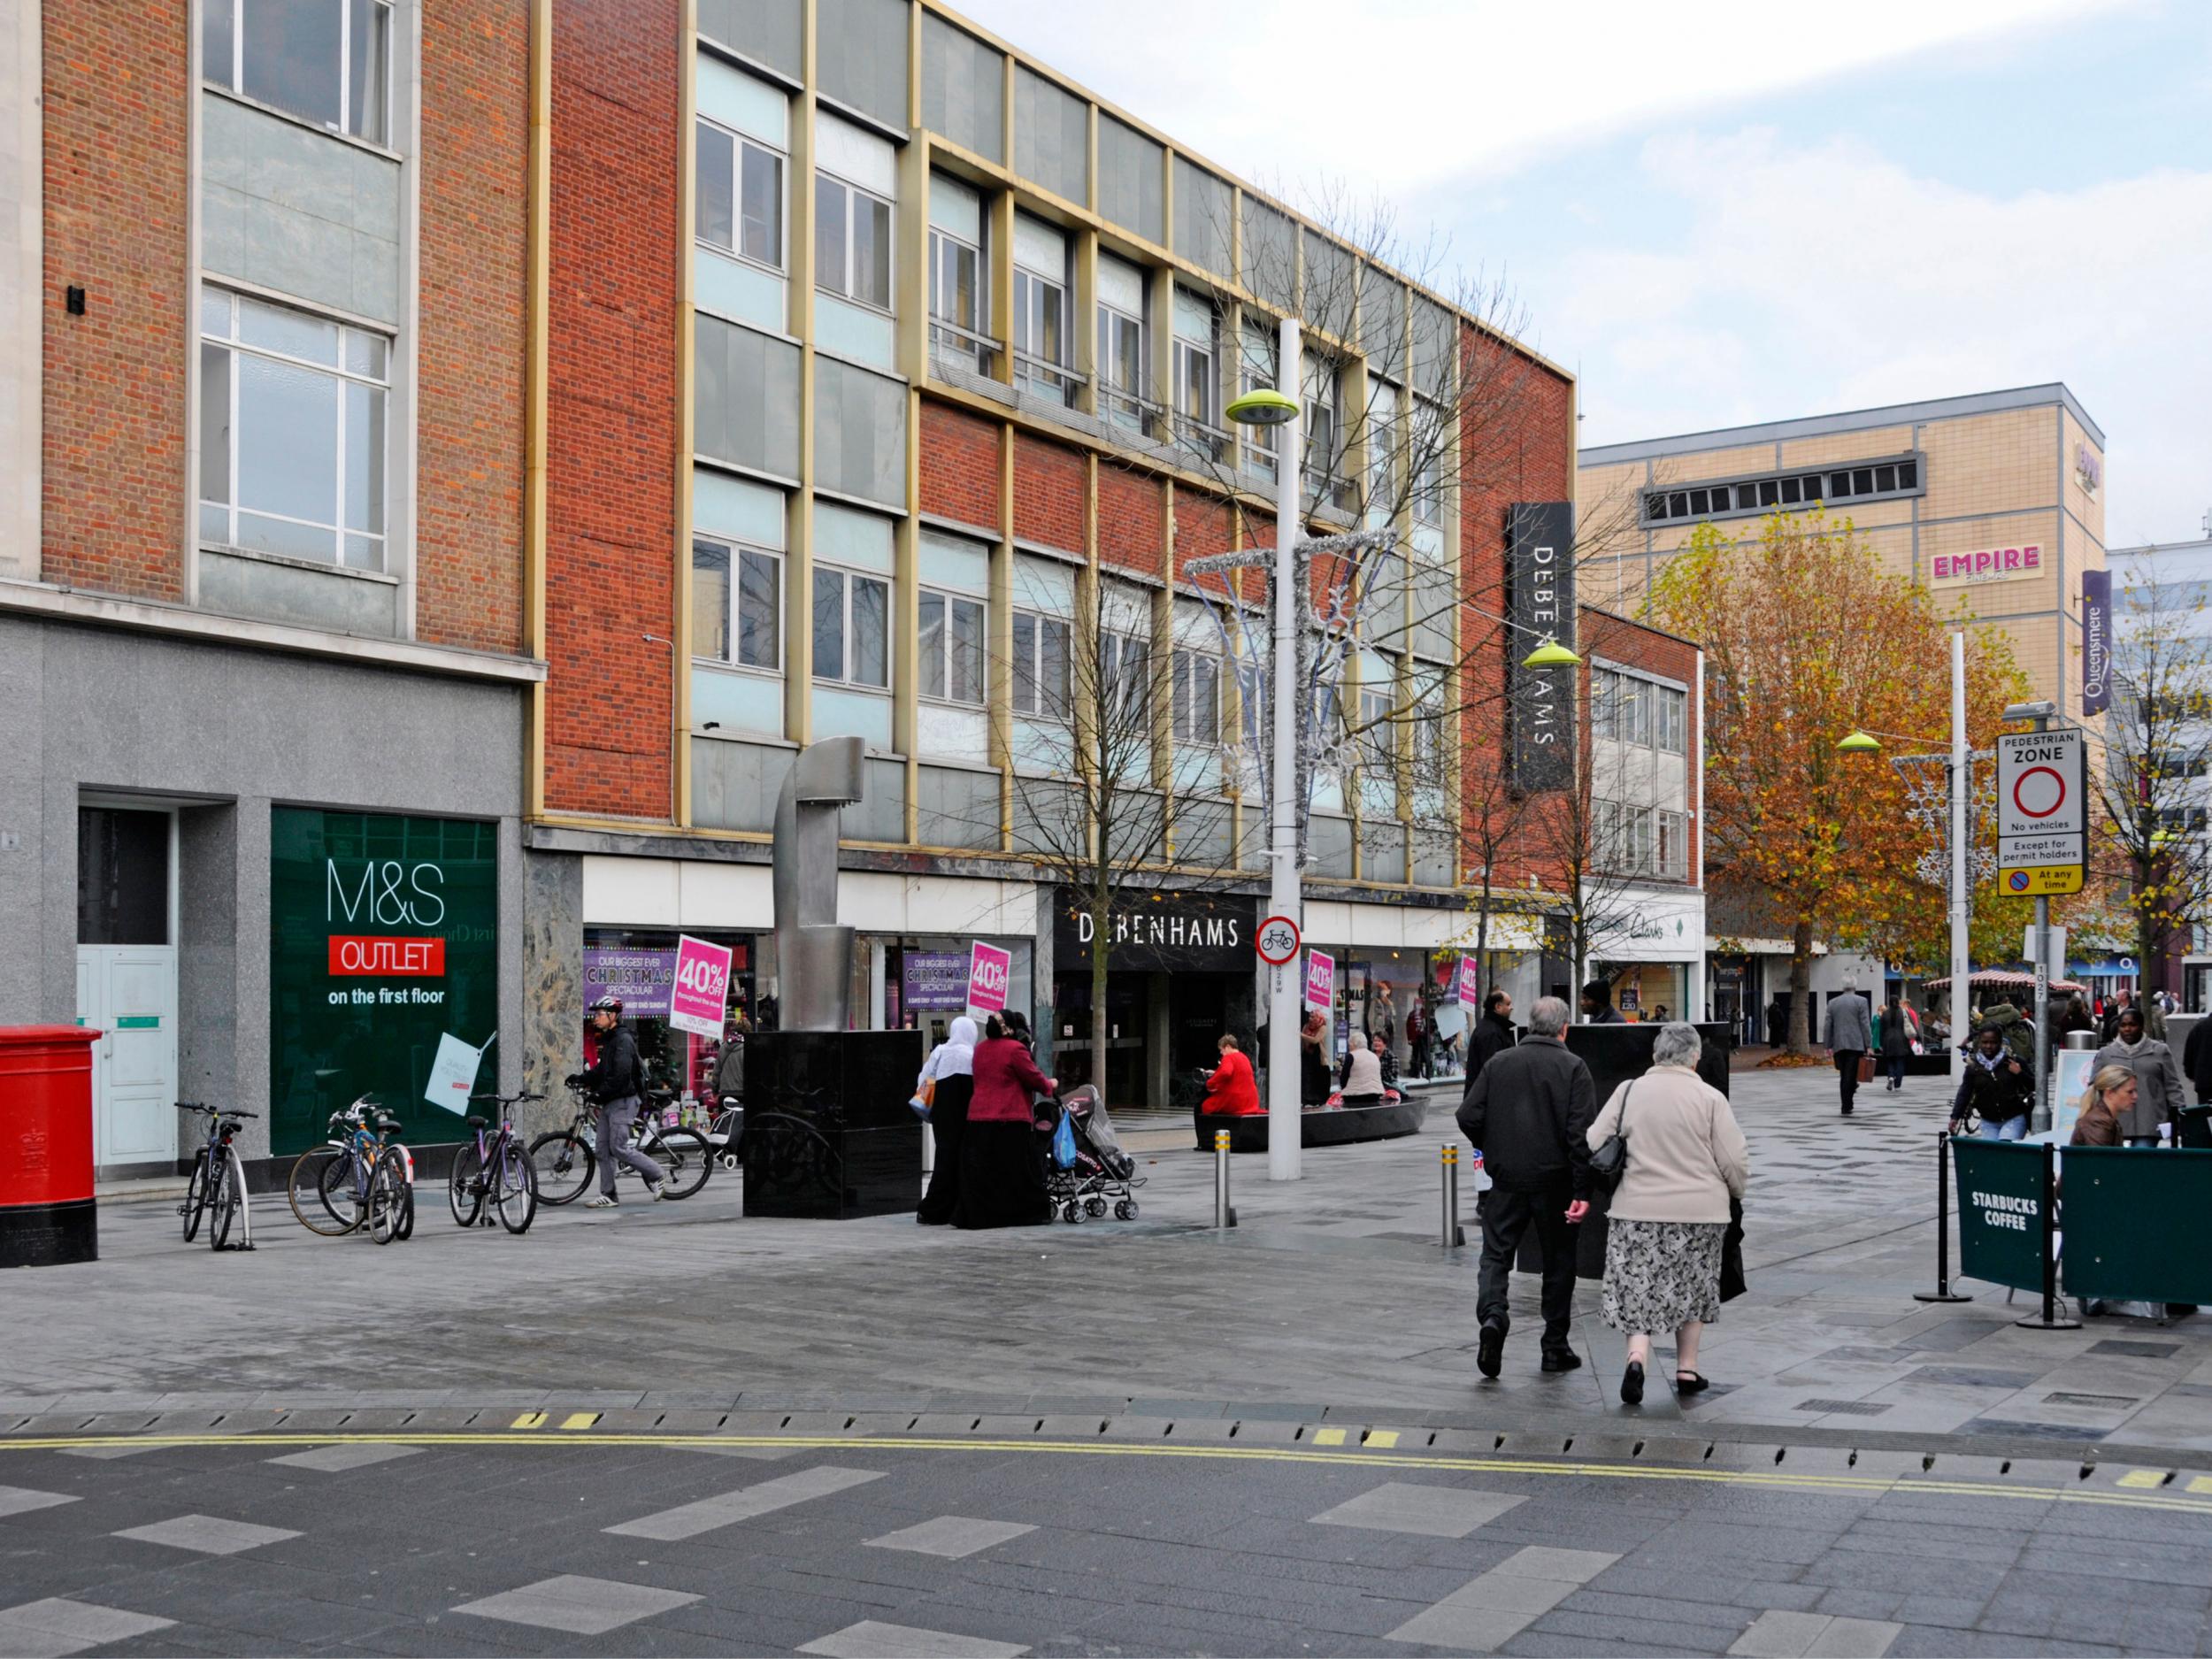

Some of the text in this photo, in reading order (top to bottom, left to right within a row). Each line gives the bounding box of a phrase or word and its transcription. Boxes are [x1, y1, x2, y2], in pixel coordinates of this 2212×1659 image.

[1933, 545, 2039, 579] EMPIRE
[1533, 546, 1554, 745] DEBENAMS
[2085, 606, 2105, 697] Queensmere
[2004, 733, 2075, 748] PEDESTRIAN
[2014, 747, 2064, 764] ZONE
[2011, 819, 2070, 832] No vehicles
[2014, 840, 2067, 852] Except for
[2003, 849, 2078, 863] permit holders
[2054, 871, 2072, 880] any
[326, 858, 445, 926] M&S
[2044, 879, 2067, 890] time
[1079, 912, 1238, 947] DBENHAMS
[1630, 912, 1663, 940] Clarks
[341, 941, 434, 971] OUTLET
[598, 956, 661, 967] OUR BIGGEST EVER
[587, 967, 672, 985] CHRISTMAS
[679, 958, 724, 993] 40%
[906, 968, 969, 983] CHRISTMAS
[972, 959, 1006, 989] 40%
[328, 987, 445, 1004] on the first floor
[606, 985, 653, 995] SPECTACULAR
[708, 985, 723, 997] OFF
[919, 983, 955, 992] SPECTACULAR
[993, 982, 1005, 993] OFF
[1971, 1191, 2038, 1215] STARBUCKS
[1985, 1210, 2026, 1232] COFFEE
